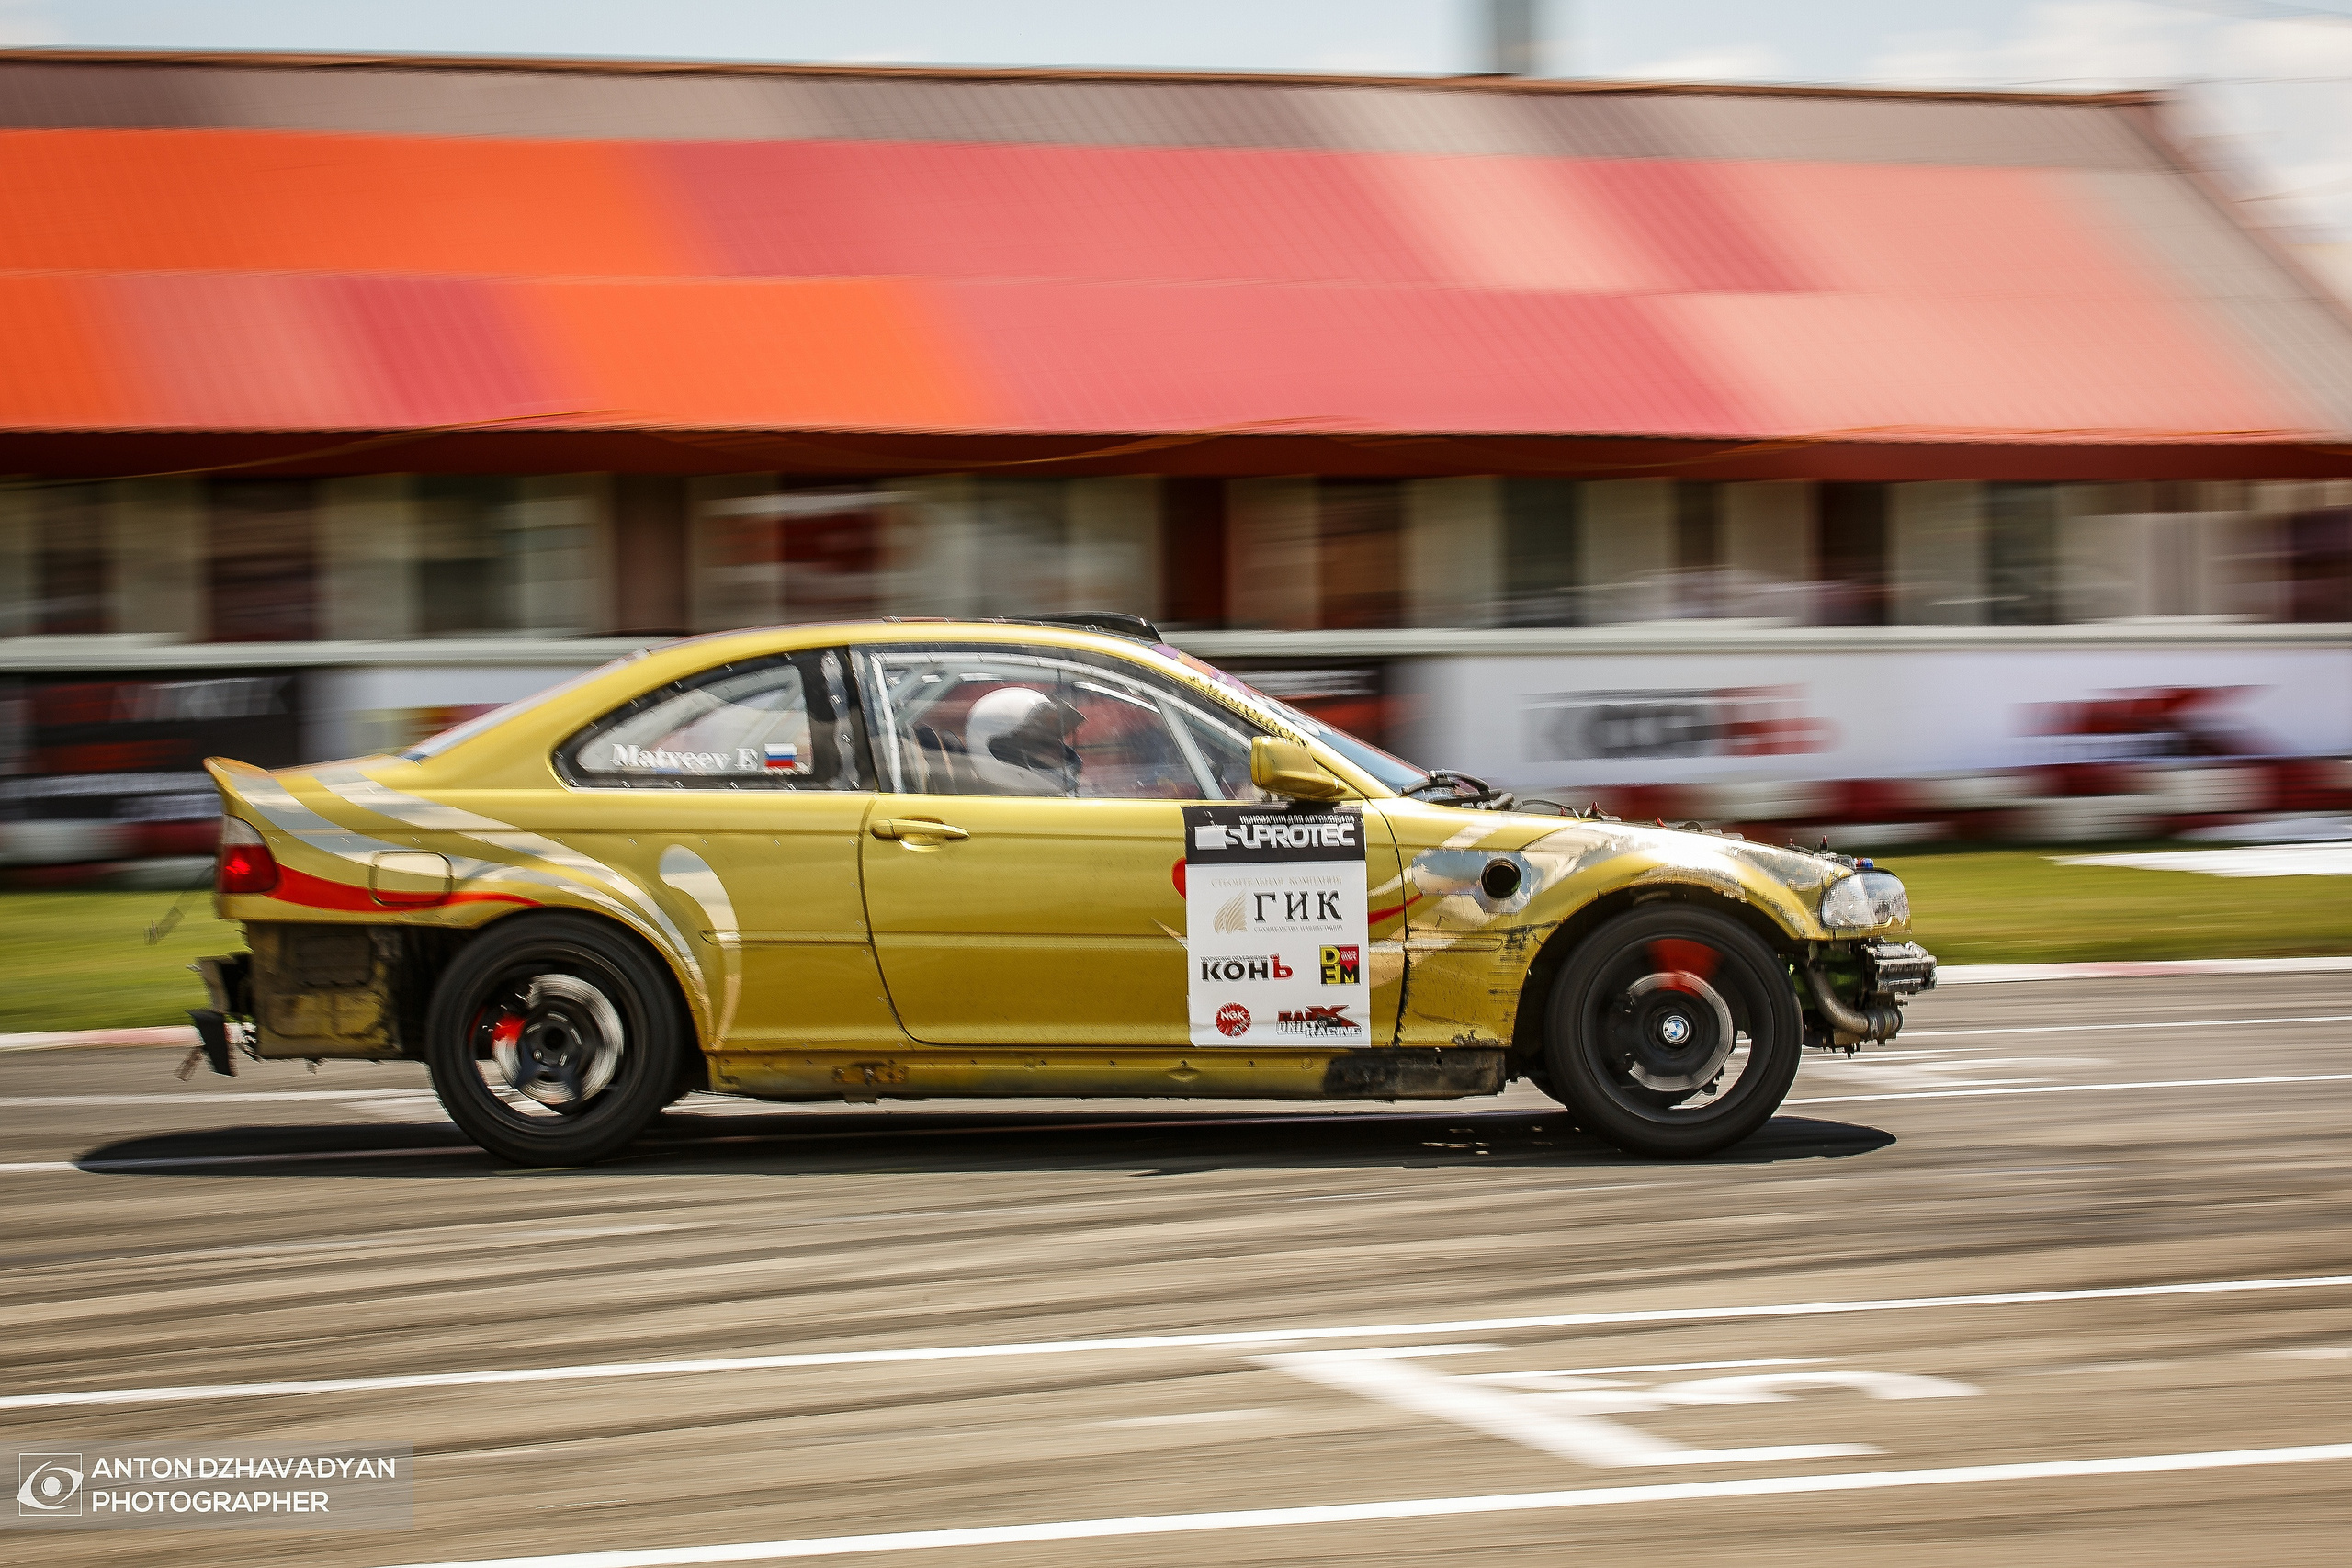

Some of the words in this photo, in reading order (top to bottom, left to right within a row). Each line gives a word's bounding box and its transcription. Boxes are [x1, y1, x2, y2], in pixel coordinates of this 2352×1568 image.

[1226, 823, 1356, 849] SUPROTEC
[1253, 889, 1342, 923] ГИК
[1201, 953, 1293, 982] КОНЬ
